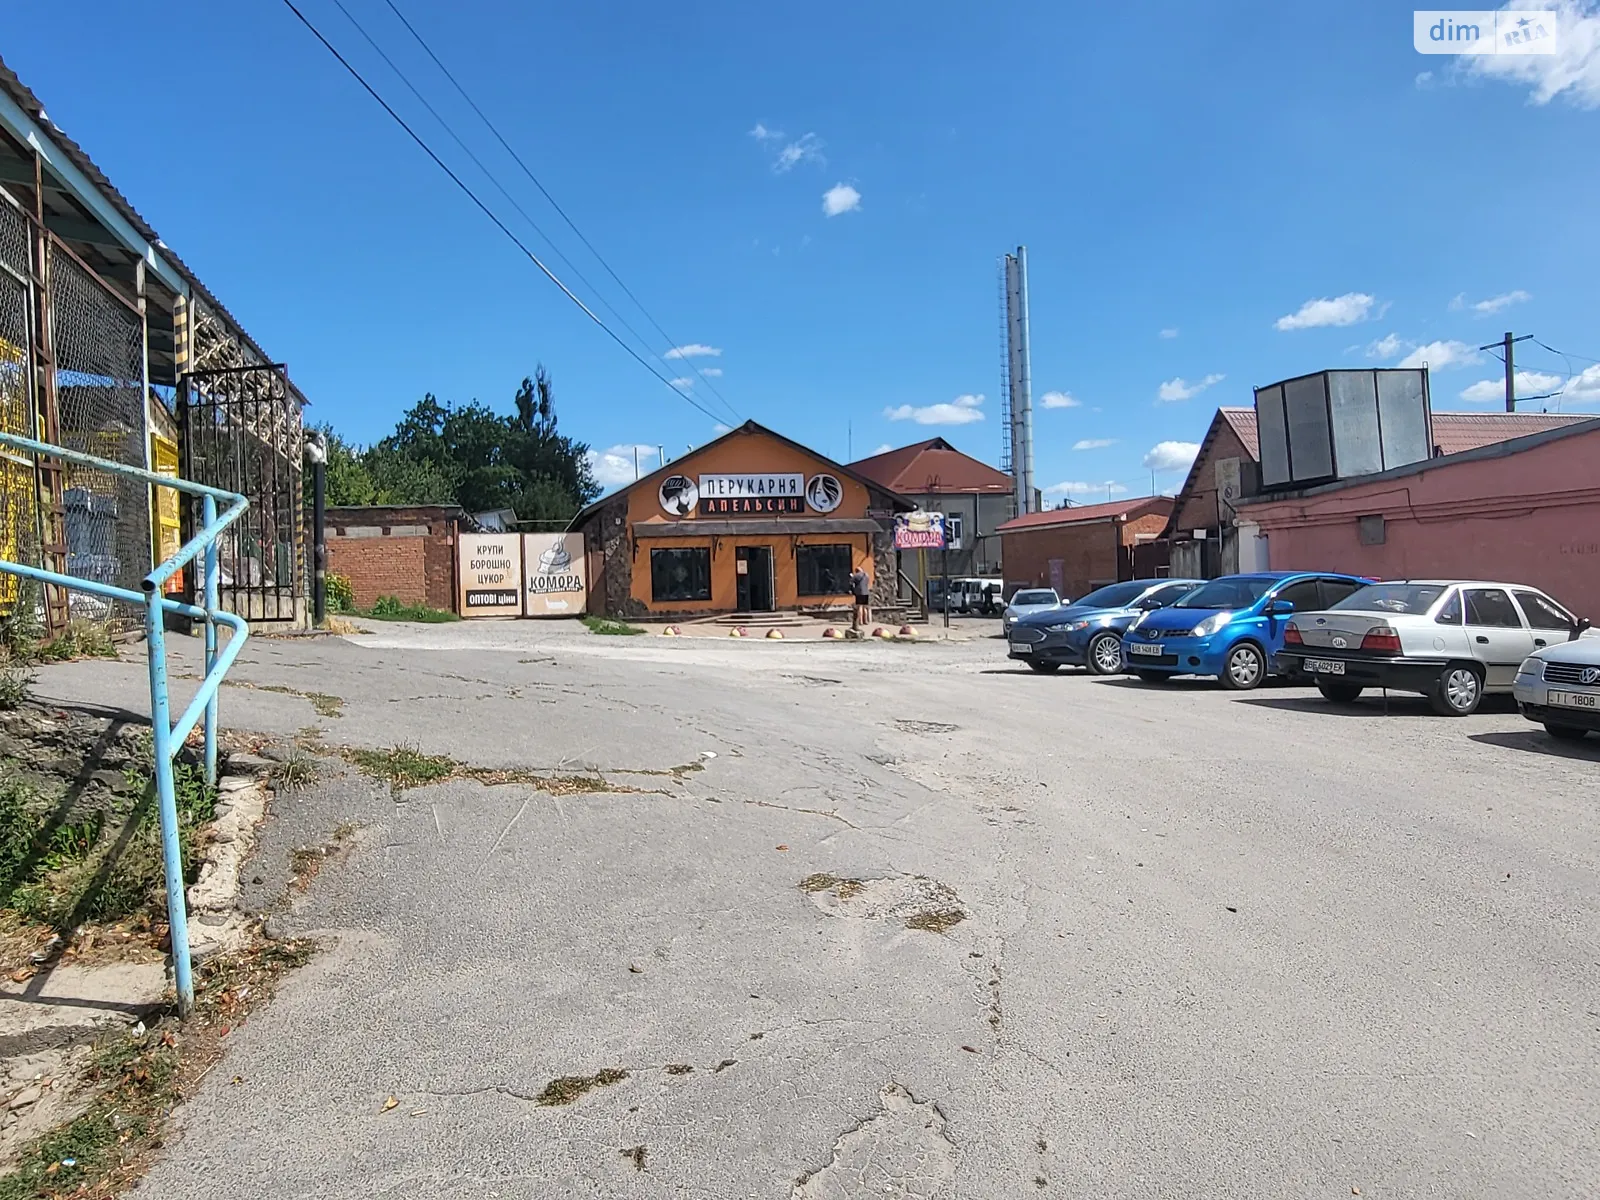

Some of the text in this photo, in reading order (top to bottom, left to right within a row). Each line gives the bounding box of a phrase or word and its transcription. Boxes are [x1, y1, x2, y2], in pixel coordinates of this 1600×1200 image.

[707, 478, 797, 495] ПЕРУКАРНЯ
[708, 498, 798, 513] АПЕЛЬСИН
[477, 545, 504, 555] КРУПИ
[470, 559, 511, 570] БОРОШНО
[477, 574, 505, 585] ЦУКОР
[530, 575, 582, 589] КОМОРА
[469, 593, 497, 605] ОПТОВІ
[1572, 695, 1596, 707] 1808
